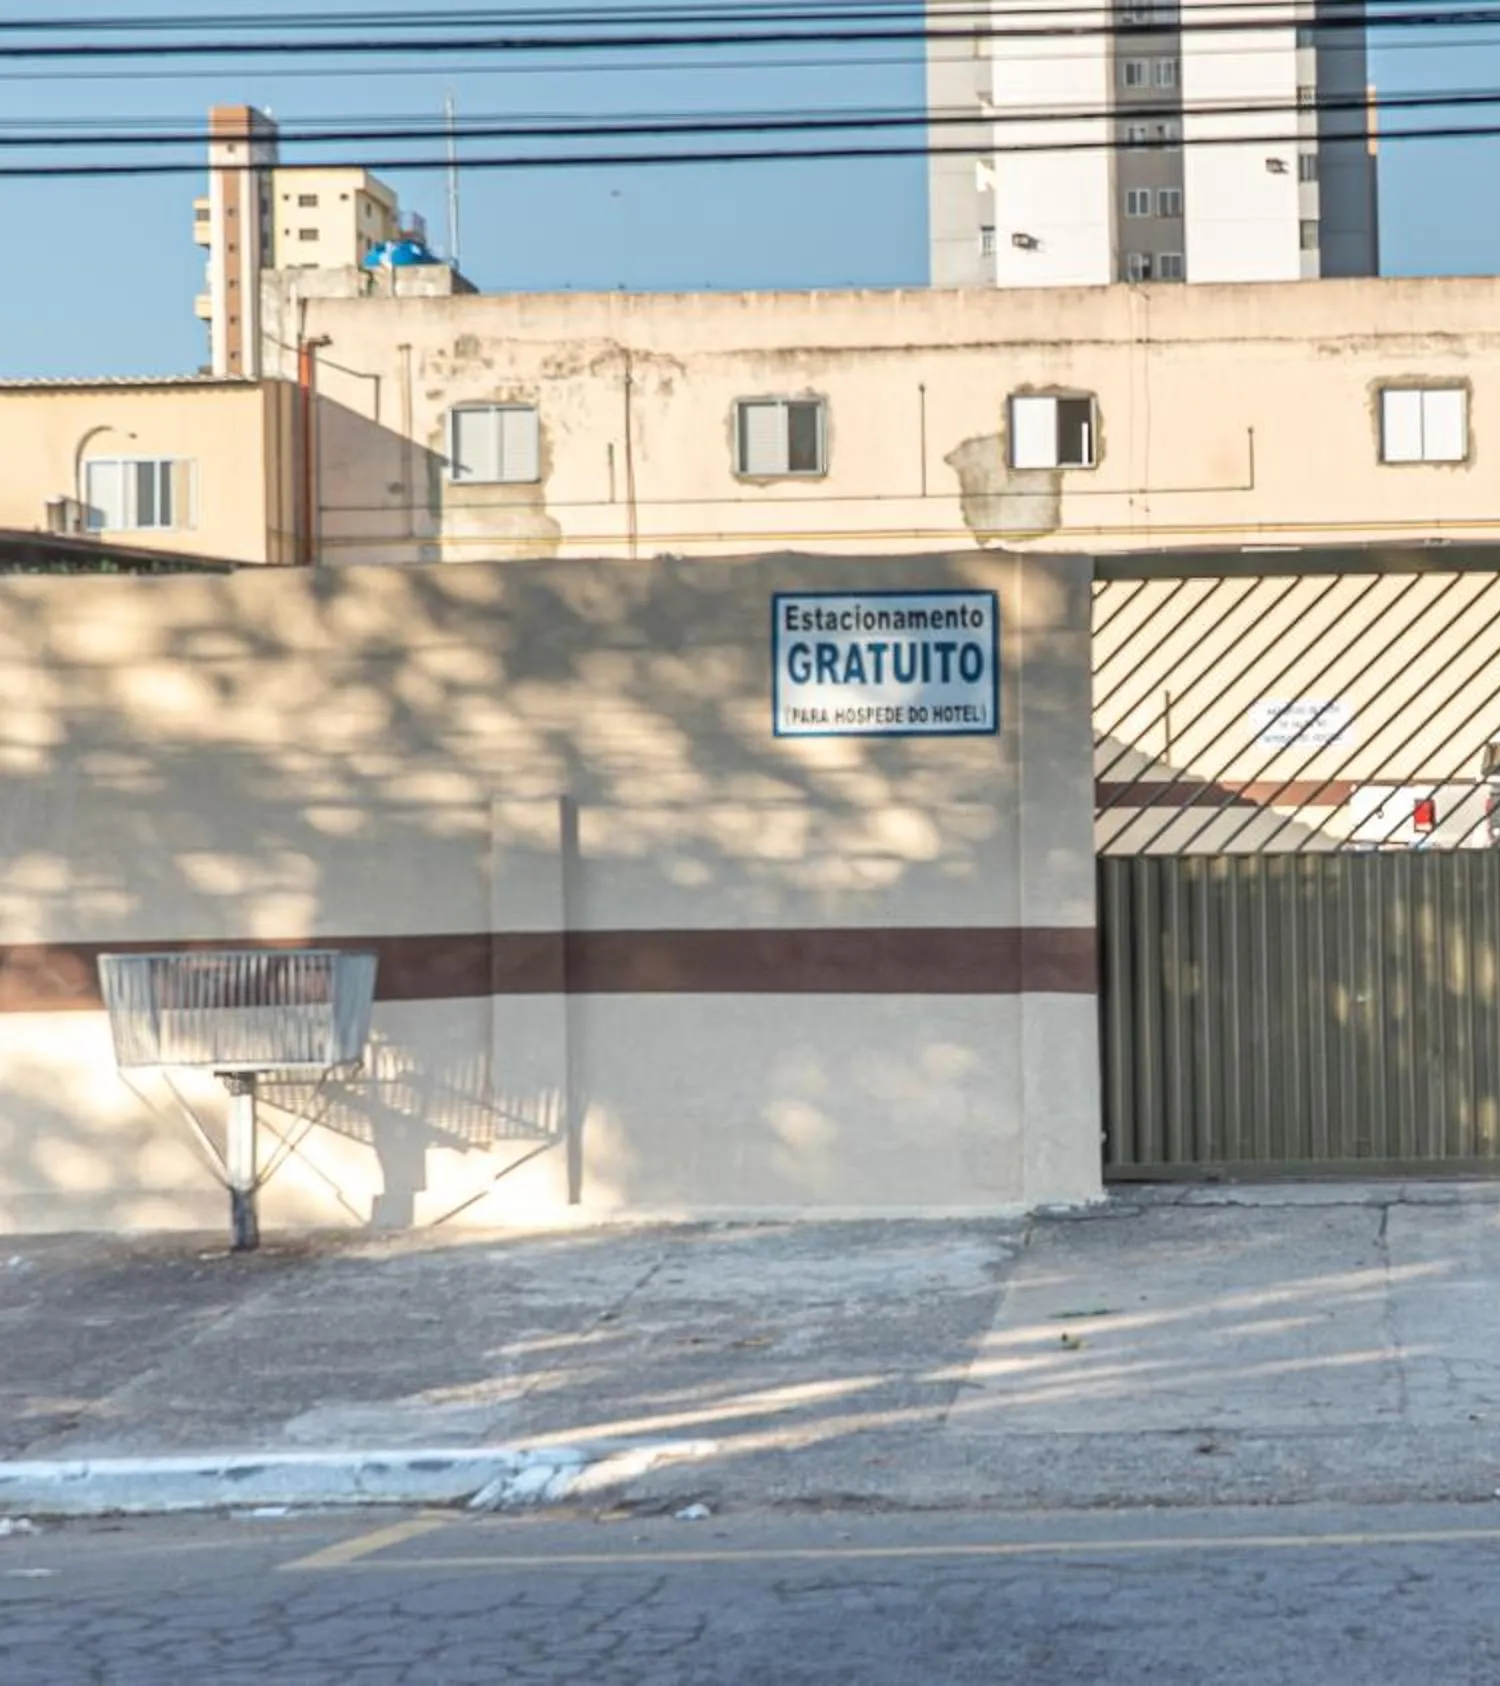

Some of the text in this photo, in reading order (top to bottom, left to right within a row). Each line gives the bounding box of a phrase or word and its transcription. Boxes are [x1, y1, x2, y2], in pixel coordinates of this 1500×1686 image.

[785, 604, 983, 631] Estacionamento
[787, 641, 984, 684] GRATUITO
[785, 704, 987, 725] (PARA HOSPEDE DO HOTEL)
